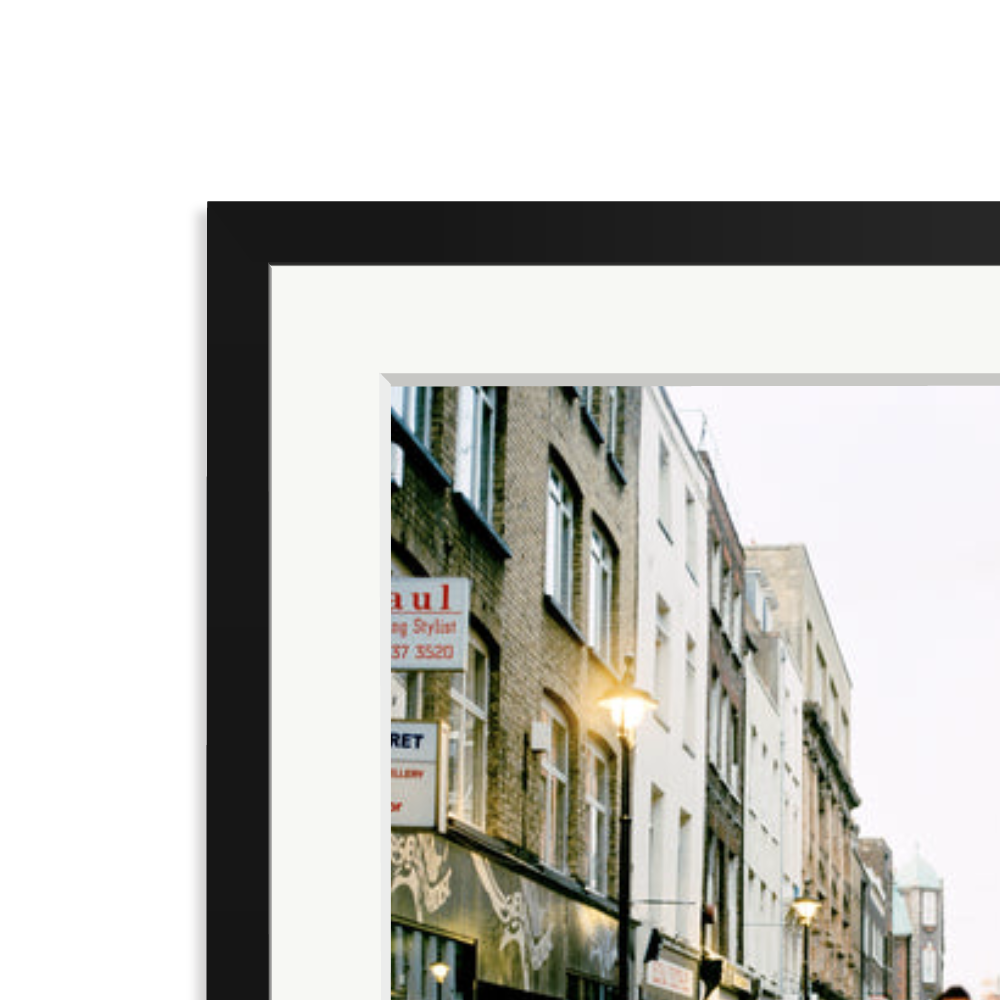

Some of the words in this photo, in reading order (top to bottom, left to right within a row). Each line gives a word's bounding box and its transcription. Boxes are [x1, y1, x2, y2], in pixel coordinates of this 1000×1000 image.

[391, 584, 450, 610] aul
[413, 617, 456, 637] Stylist
[391, 644, 410, 659] 37
[414, 644, 454, 659] 3520
[391, 732, 425, 749] RET
